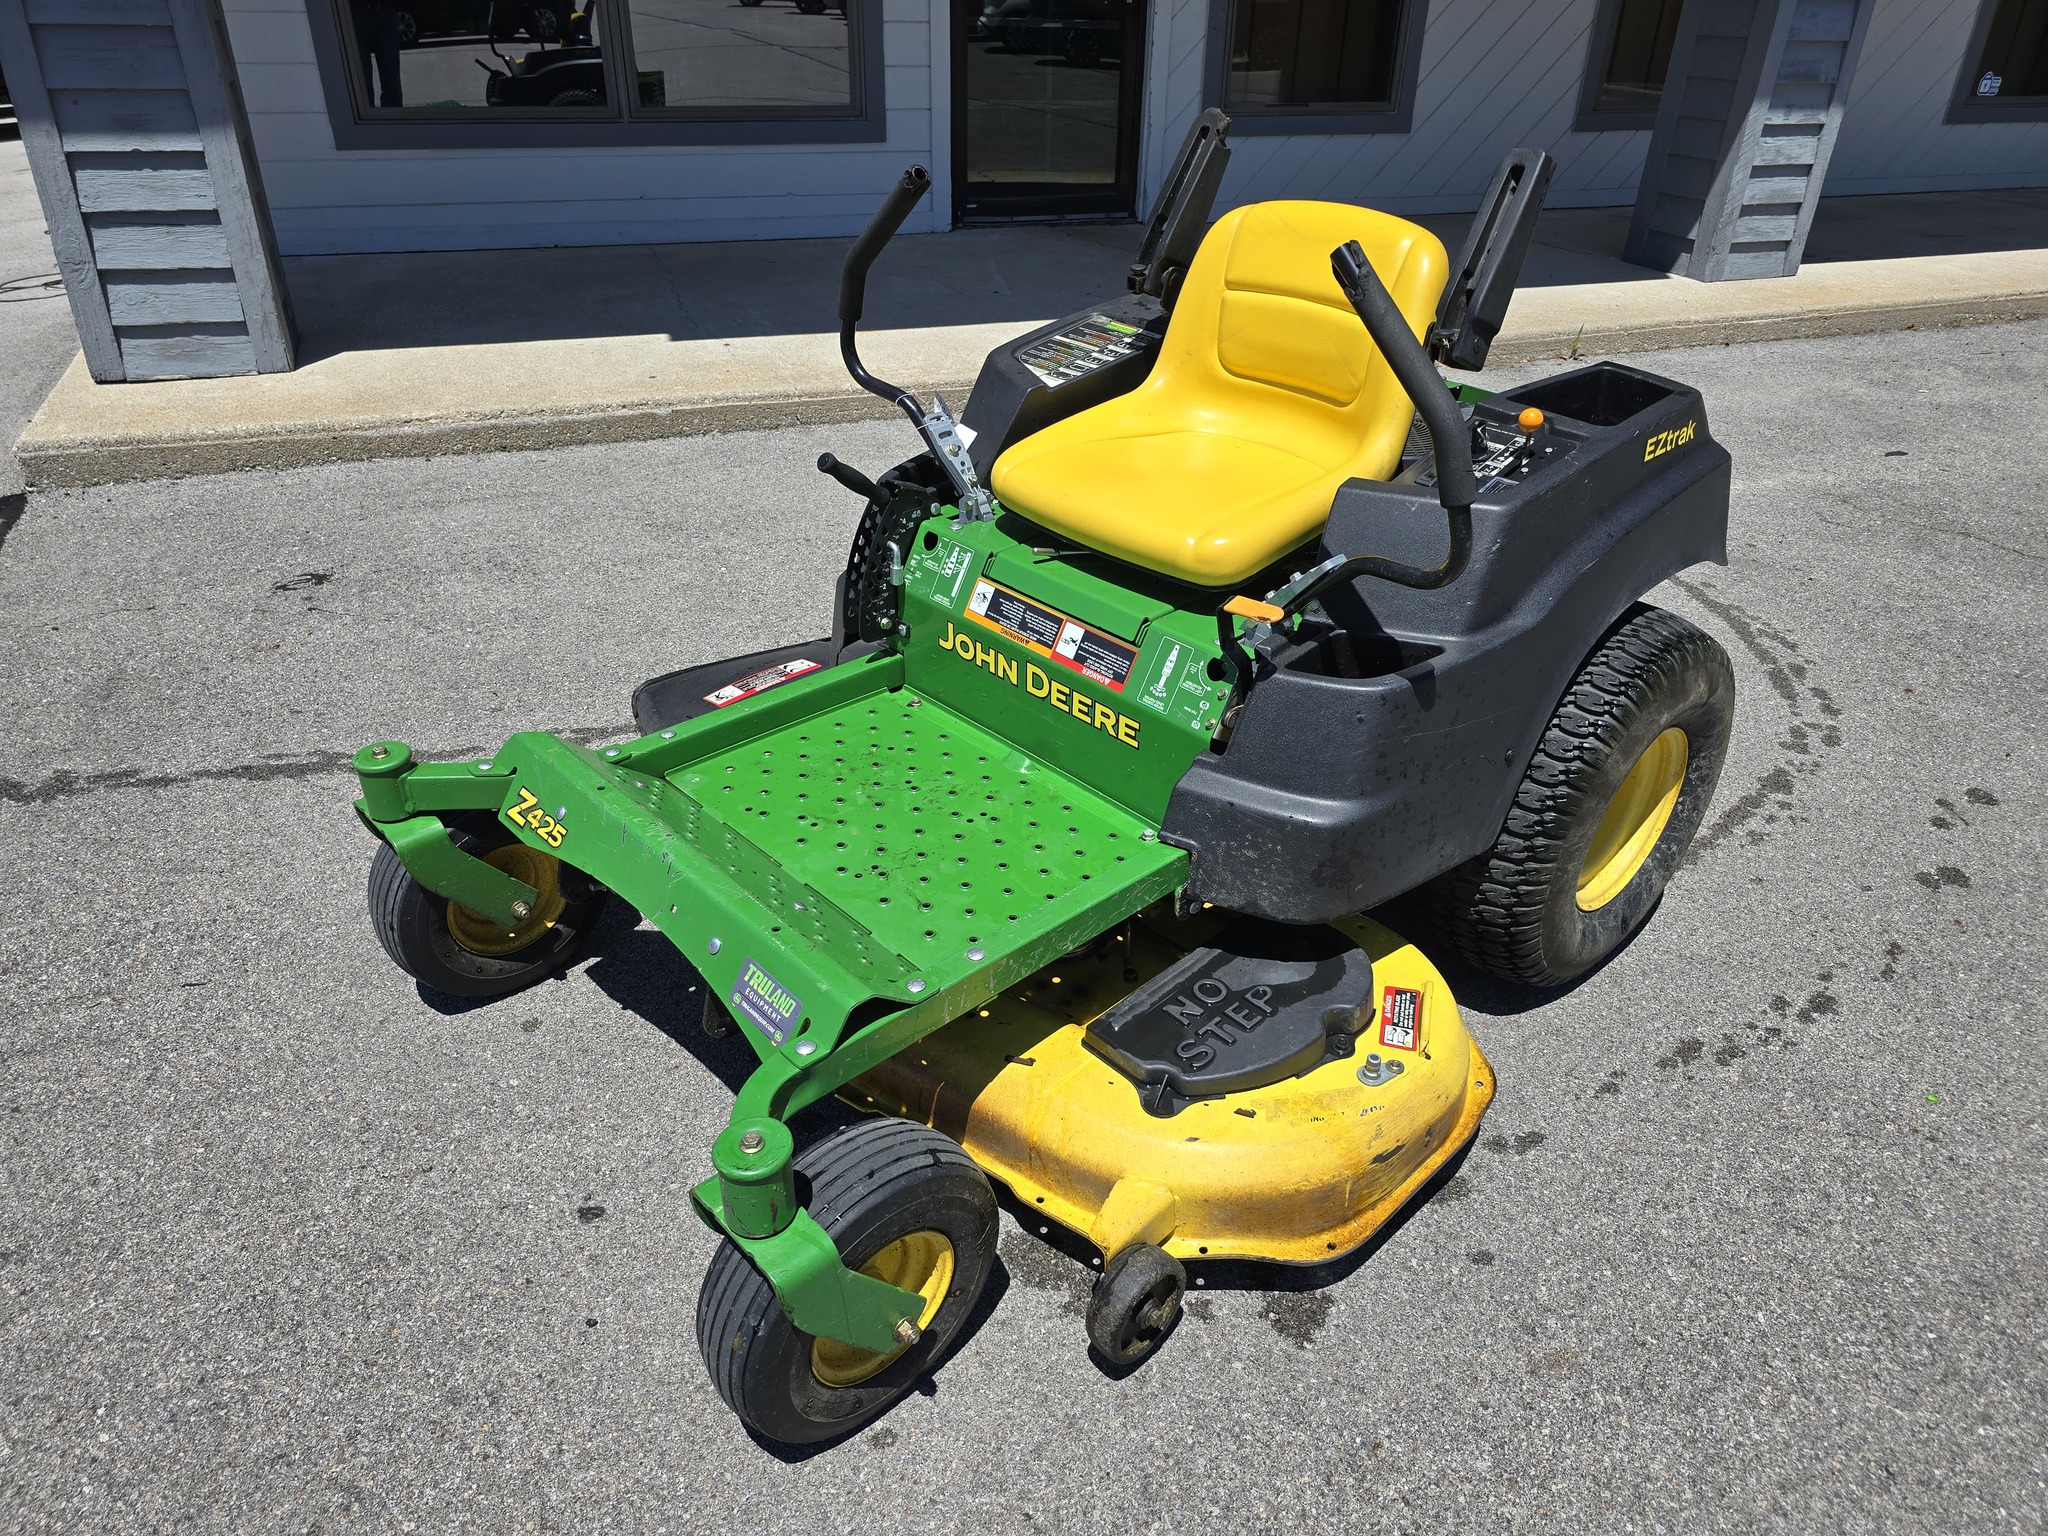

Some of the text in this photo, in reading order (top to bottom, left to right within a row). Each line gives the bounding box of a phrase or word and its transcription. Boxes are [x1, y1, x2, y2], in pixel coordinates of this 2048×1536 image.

[1643, 420, 1697, 463] EZtrak
[999, 627, 1025, 644] WARNING
[938, 622, 1141, 750] JOHN DEERE
[1081, 666, 1104, 682] DANGER
[506, 786, 569, 849] Z425
[743, 963, 797, 1018] TRULAND
[745, 987, 781, 1022] EQUIPMENT
[1162, 978, 1229, 1029] NO
[1175, 985, 1276, 1068] STEP
